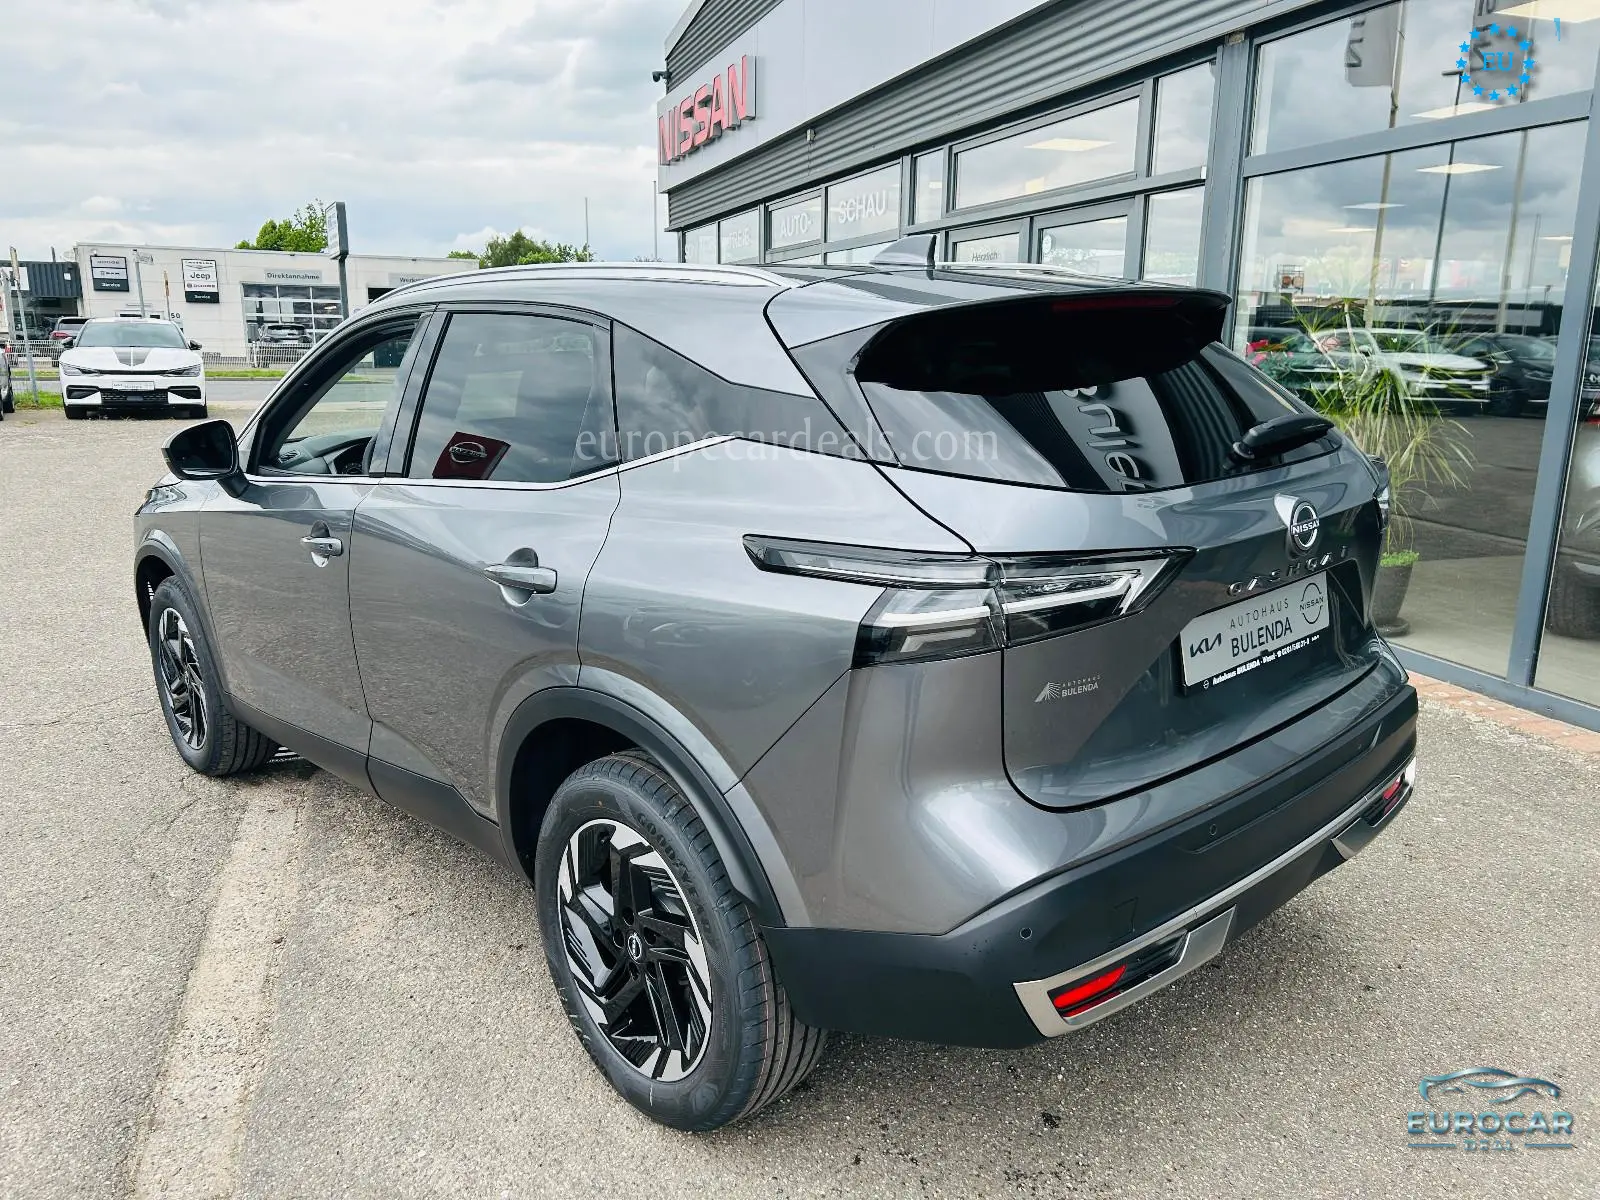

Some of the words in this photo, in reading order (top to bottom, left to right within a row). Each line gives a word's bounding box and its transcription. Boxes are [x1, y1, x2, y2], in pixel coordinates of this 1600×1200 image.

[658, 54, 757, 166] NISSAN
[837, 191, 888, 224] SCHAU
[190, 271, 211, 281] Jeep
[266, 271, 320, 280] Direktannahme
[1291, 519, 1320, 536] NISSAN
[1299, 595, 1325, 612] NISSAN
[1229, 598, 1290, 629] AUTOHAUS
[1231, 616, 1294, 658] BULENDA
[1061, 681, 1100, 698] BULENDA
